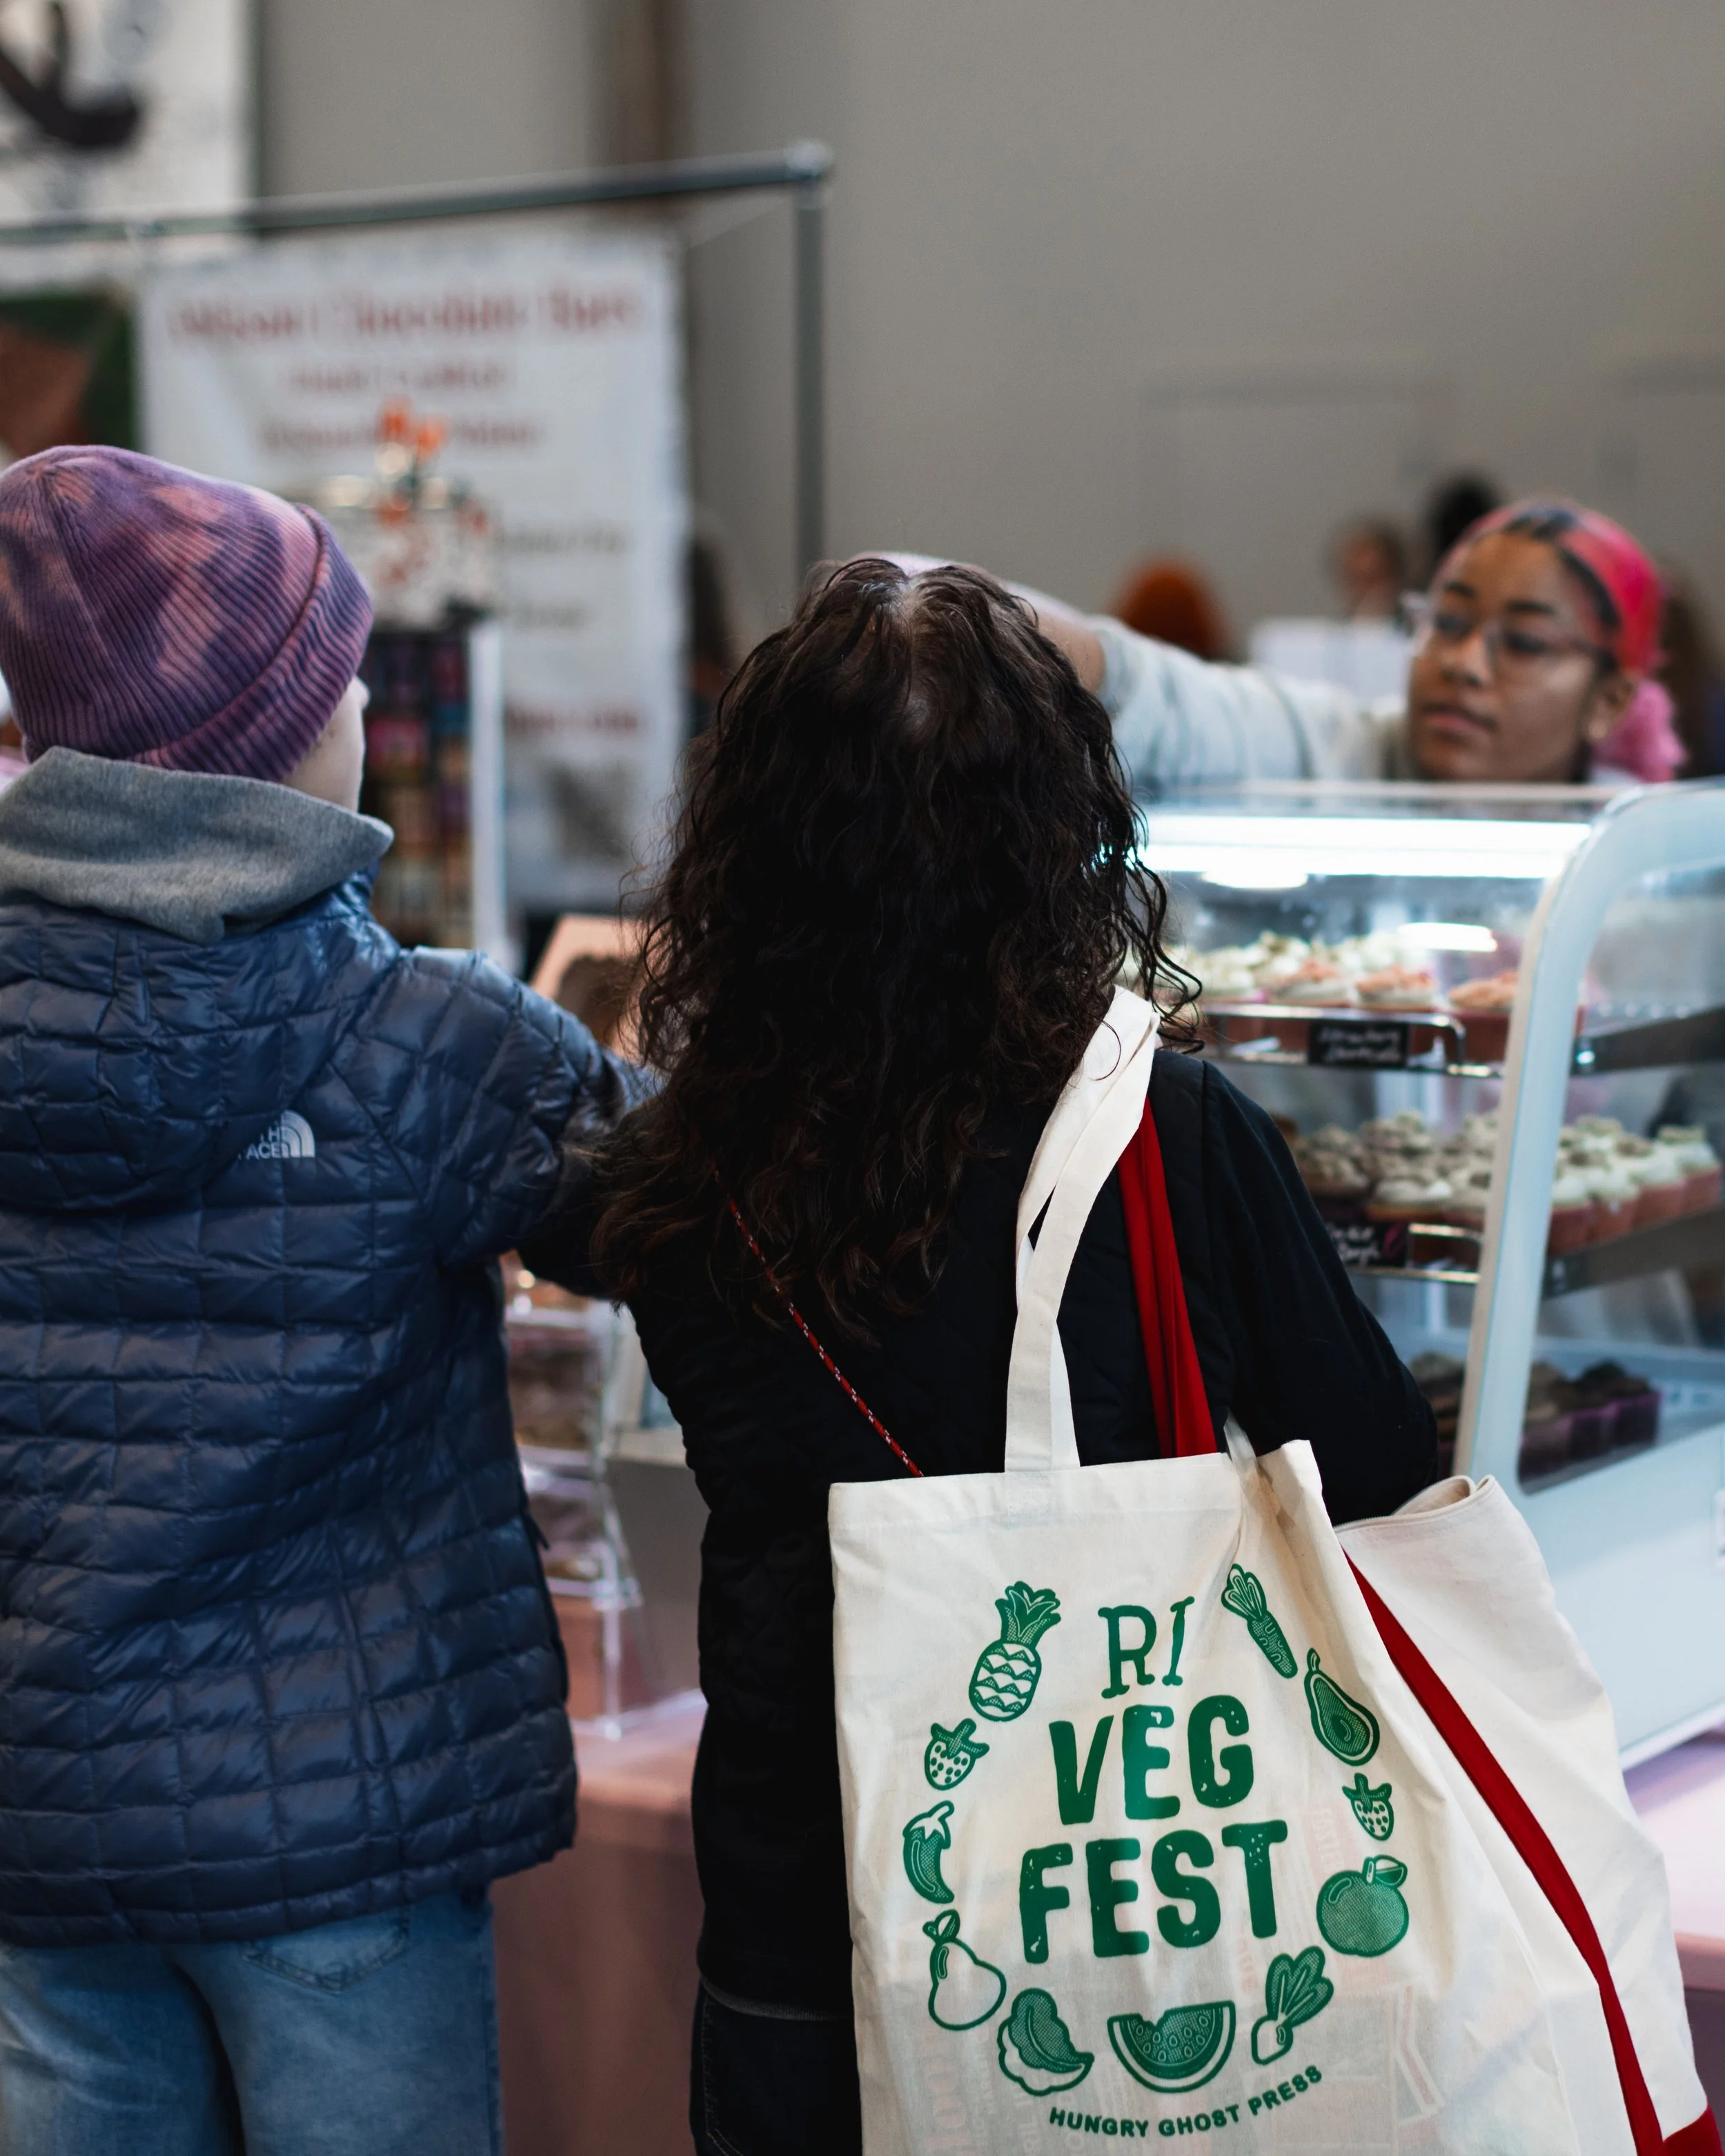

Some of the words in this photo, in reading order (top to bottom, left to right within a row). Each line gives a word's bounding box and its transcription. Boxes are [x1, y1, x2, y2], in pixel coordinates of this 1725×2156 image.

[237, 1143, 282, 1160] ACE
[1097, 1596, 1195, 1699] RI
[1049, 1695, 1254, 1826] VEG
[1019, 1819, 1288, 1963] FEST
[1049, 2107, 1147, 2137] HUNGRY
[1159, 2105, 1239, 2137] GHOST
[1248, 2066, 1322, 2115] PRESS
